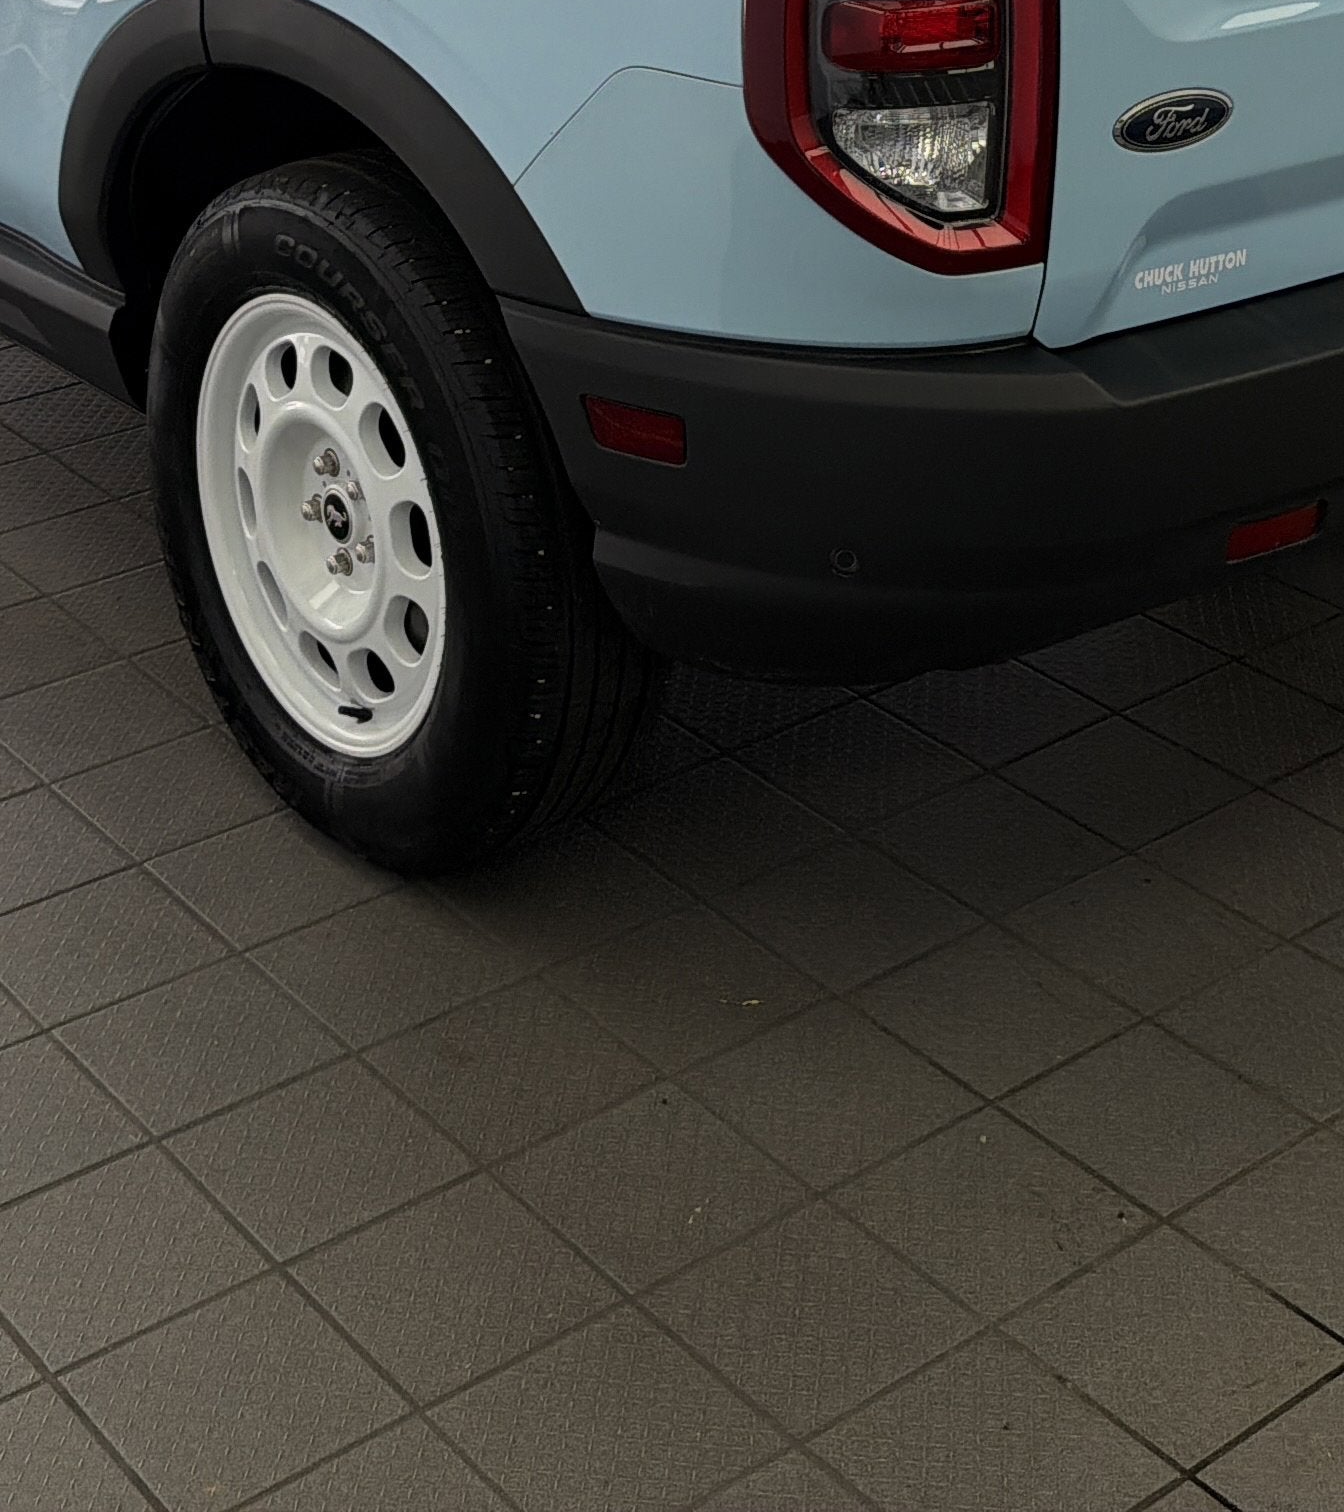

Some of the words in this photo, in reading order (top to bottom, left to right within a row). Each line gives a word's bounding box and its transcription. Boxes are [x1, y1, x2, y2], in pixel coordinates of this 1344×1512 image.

[1145, 103, 1210, 142] Ford
[1134, 262, 1184, 290] CHUCK
[1188, 249, 1248, 278] HUTTON
[1161, 273, 1220, 295] NISSAN
[274, 234, 425, 410] COURSER
